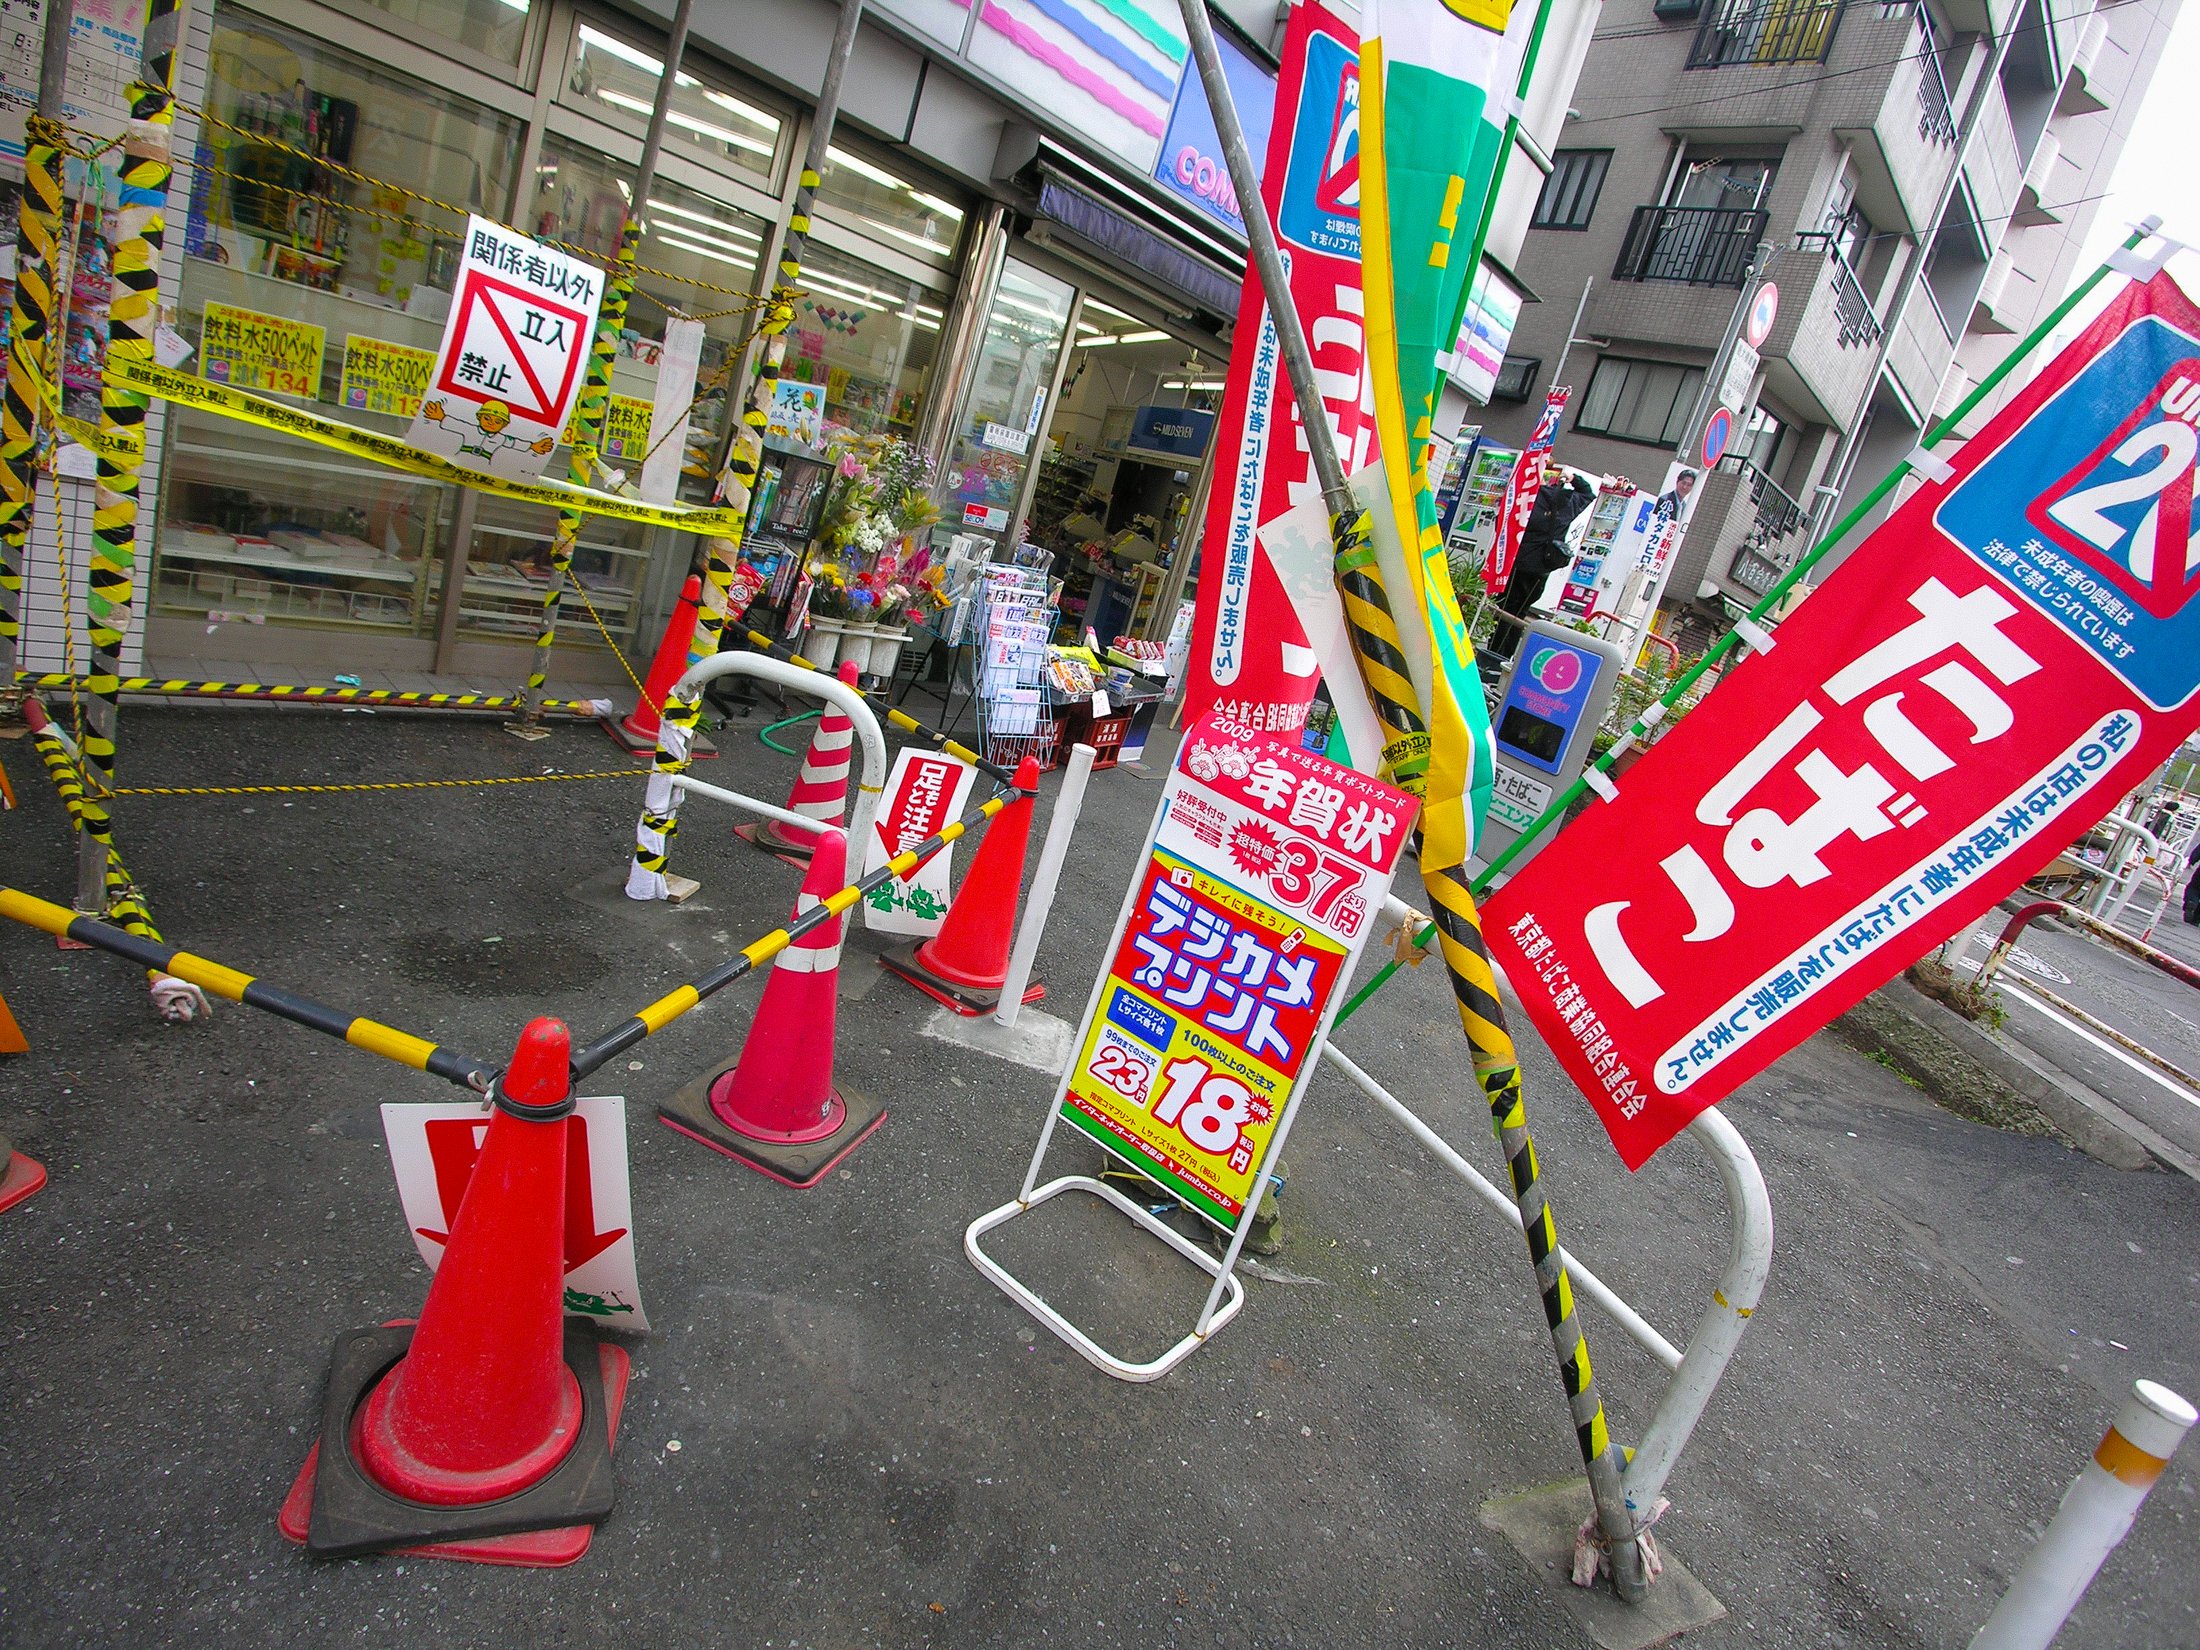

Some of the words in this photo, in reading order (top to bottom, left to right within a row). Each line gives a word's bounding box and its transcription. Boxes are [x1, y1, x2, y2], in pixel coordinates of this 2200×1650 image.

[471, 230, 594, 305] 関係者以外
[204, 314, 317, 365] 飲料水500ペット
[519, 309, 566, 353] 立入
[126, 365, 229, 406] 関係者以外立入禁止
[264, 369, 309, 394] 134
[458, 351, 512, 394] 禁止
[243, 400, 335, 435] 関係者以外立入禁止
[1639, 499, 1673, 565] 小林タカヒロ
[1982, 538, 2135, 659] 法律で禁じられています
[2020, 538, 2134, 626] 未成年者の喫煙は
[1210, 717, 1255, 743] 2009
[1266, 740, 1407, 809] 写真で送る年賀ポストカード
[1584, 574, 2043, 1010] たばこ
[1176, 788, 1228, 823] 好評受付中
[1242, 758, 1397, 864] 年賀状
[1235, 831, 1276, 862] 超特価
[1198, 879, 1286, 931] キレイに残そう!
[1268, 837, 1367, 925] 37
[1331, 905, 1364, 938] 円
[1667, 713, 2134, 1090] 私の店は未成年者にたばこを販売しません。
[1147, 876, 1318, 1007] デジカメ
[1120, 994, 1168, 1026] 全コマプリント
[1133, 933, 1293, 1063] プリント
[1508, 912, 1648, 1121] 東京都たばこ商業協同組合連合会
[1089, 1045, 1149, 1098] 23
[1105, 1028, 1158, 1068] 99枚までのご注文
[1183, 1028, 1277, 1094] 100枚以上のご注文
[1151, 1055, 1254, 1156] 18
[1249, 1099, 1269, 1118] お得
[1228, 1148, 1253, 1175] 円
[1239, 1135, 1255, 1152] 税込
